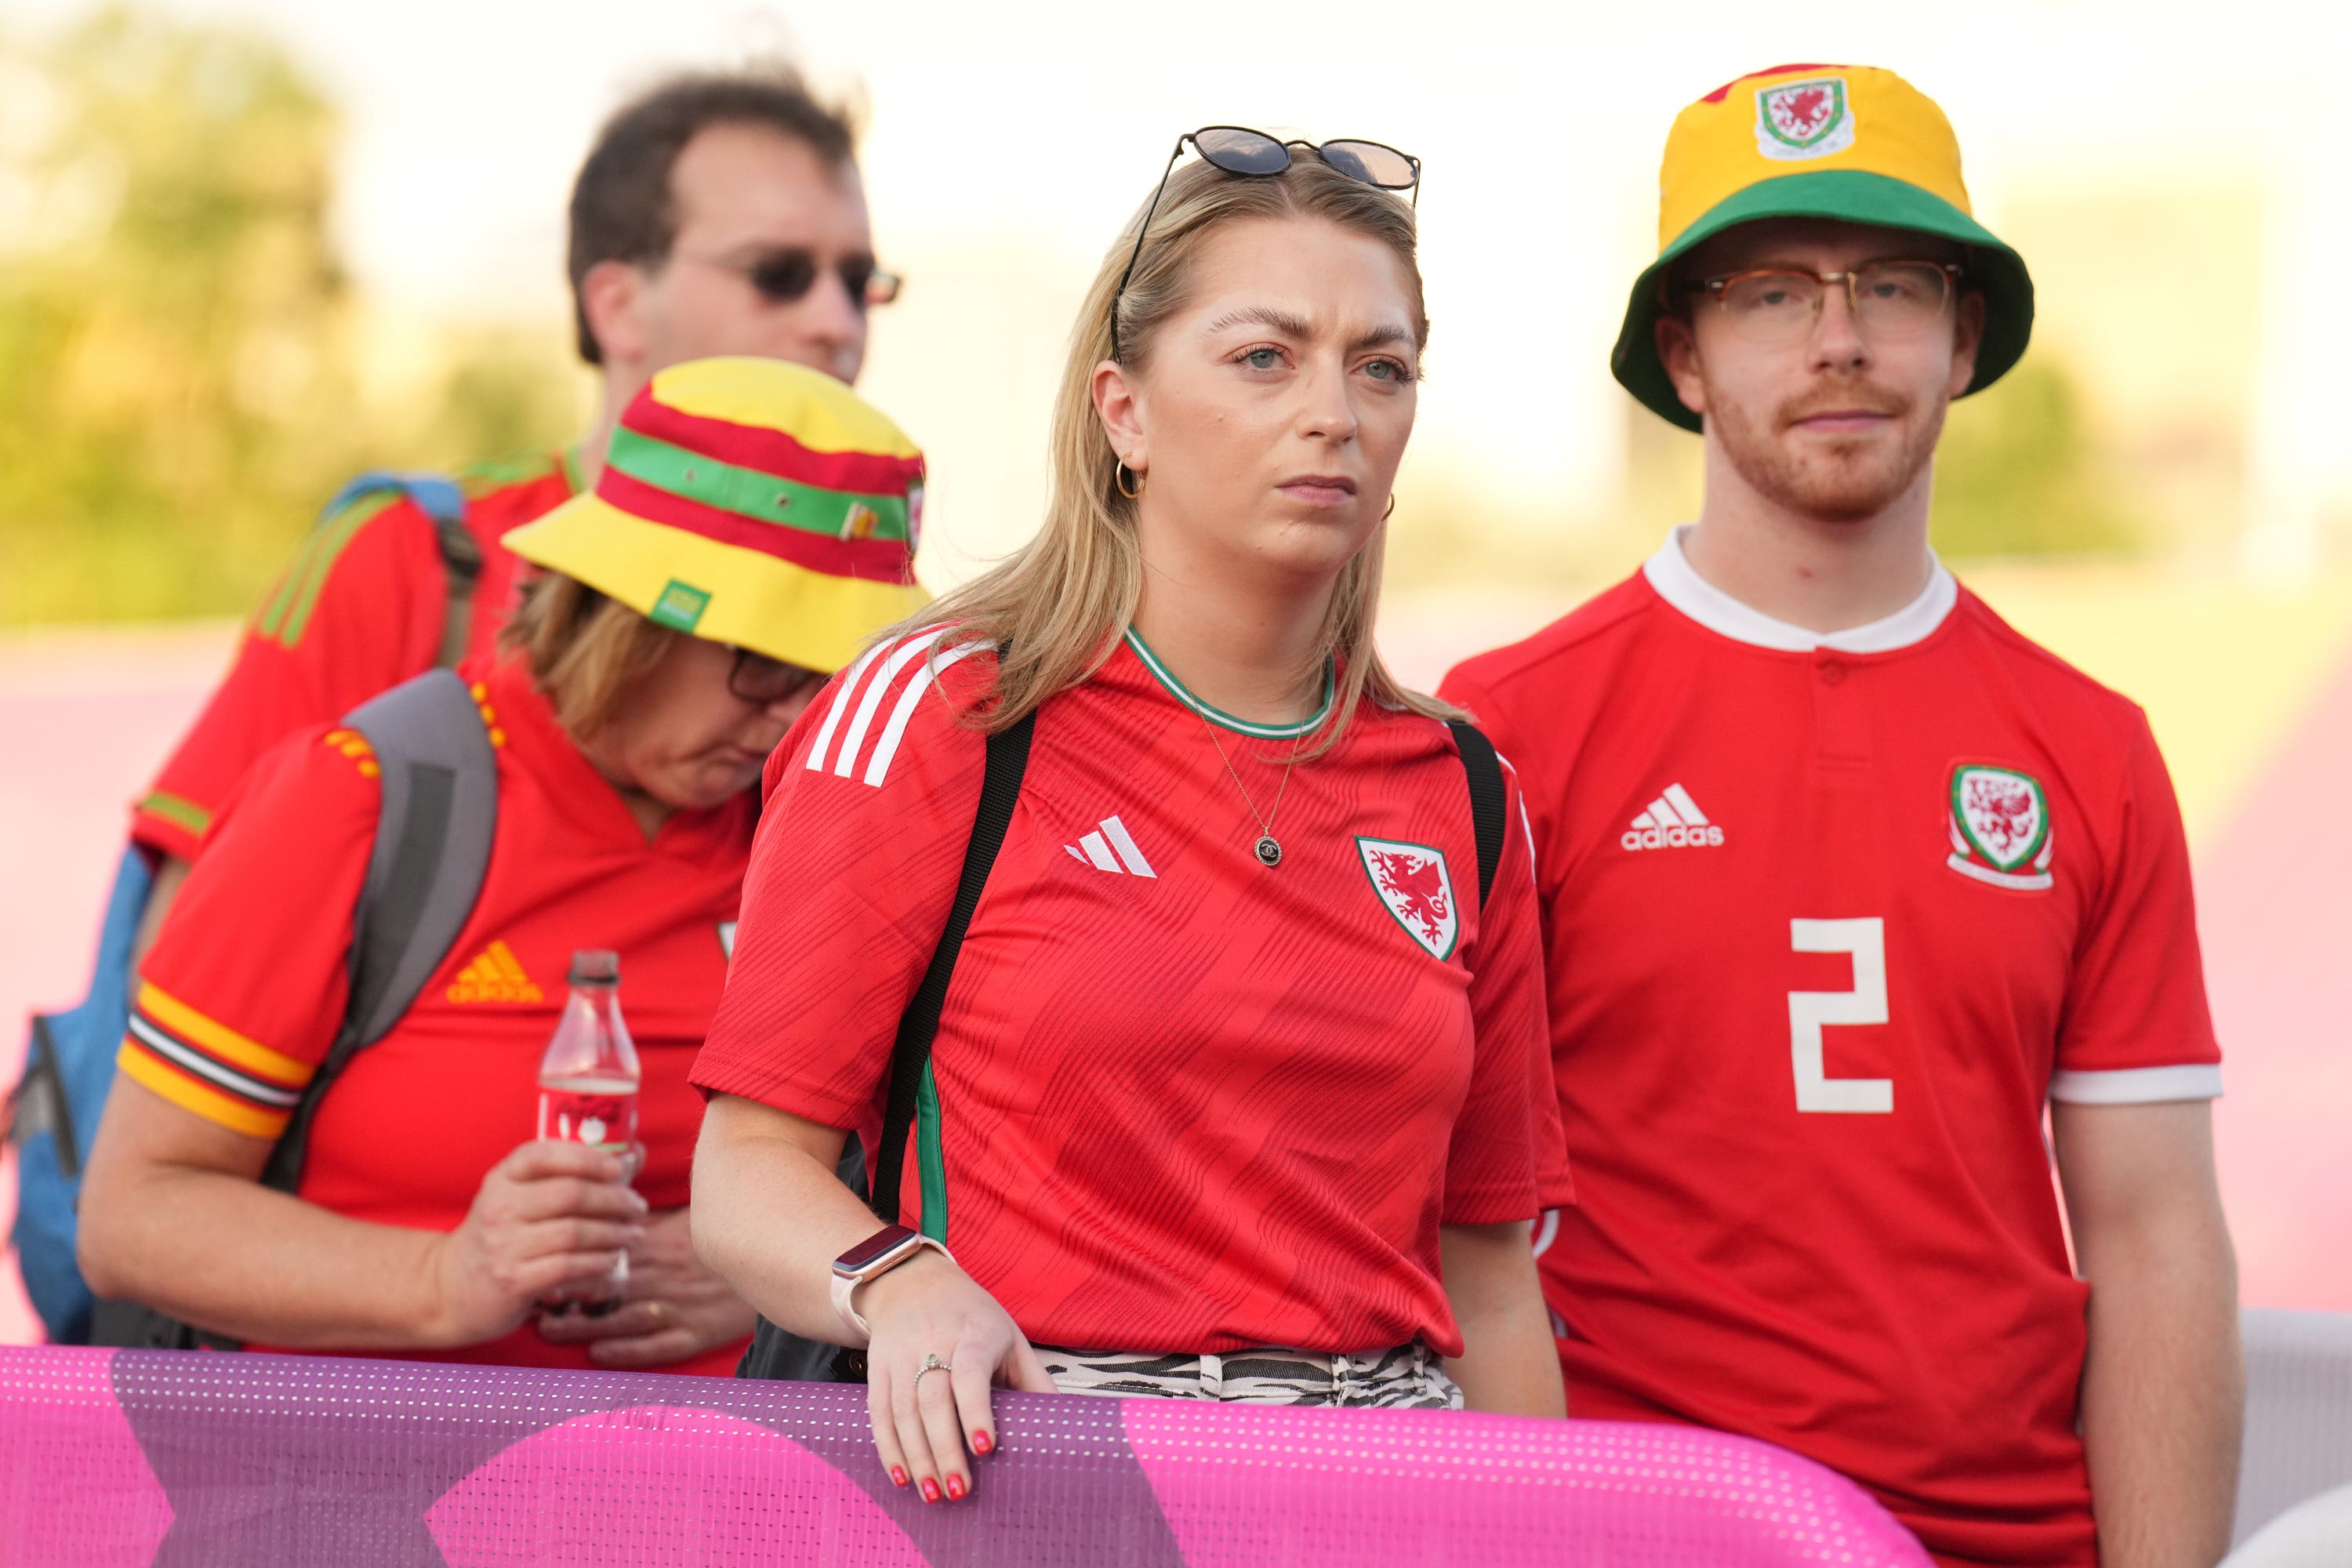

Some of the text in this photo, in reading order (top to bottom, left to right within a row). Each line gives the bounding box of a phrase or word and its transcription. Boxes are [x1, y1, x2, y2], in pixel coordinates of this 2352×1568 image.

[1621, 825, 1724, 851] adidas
[446, 981, 544, 1004] adidas
[1788, 916, 1893, 1112] 2
